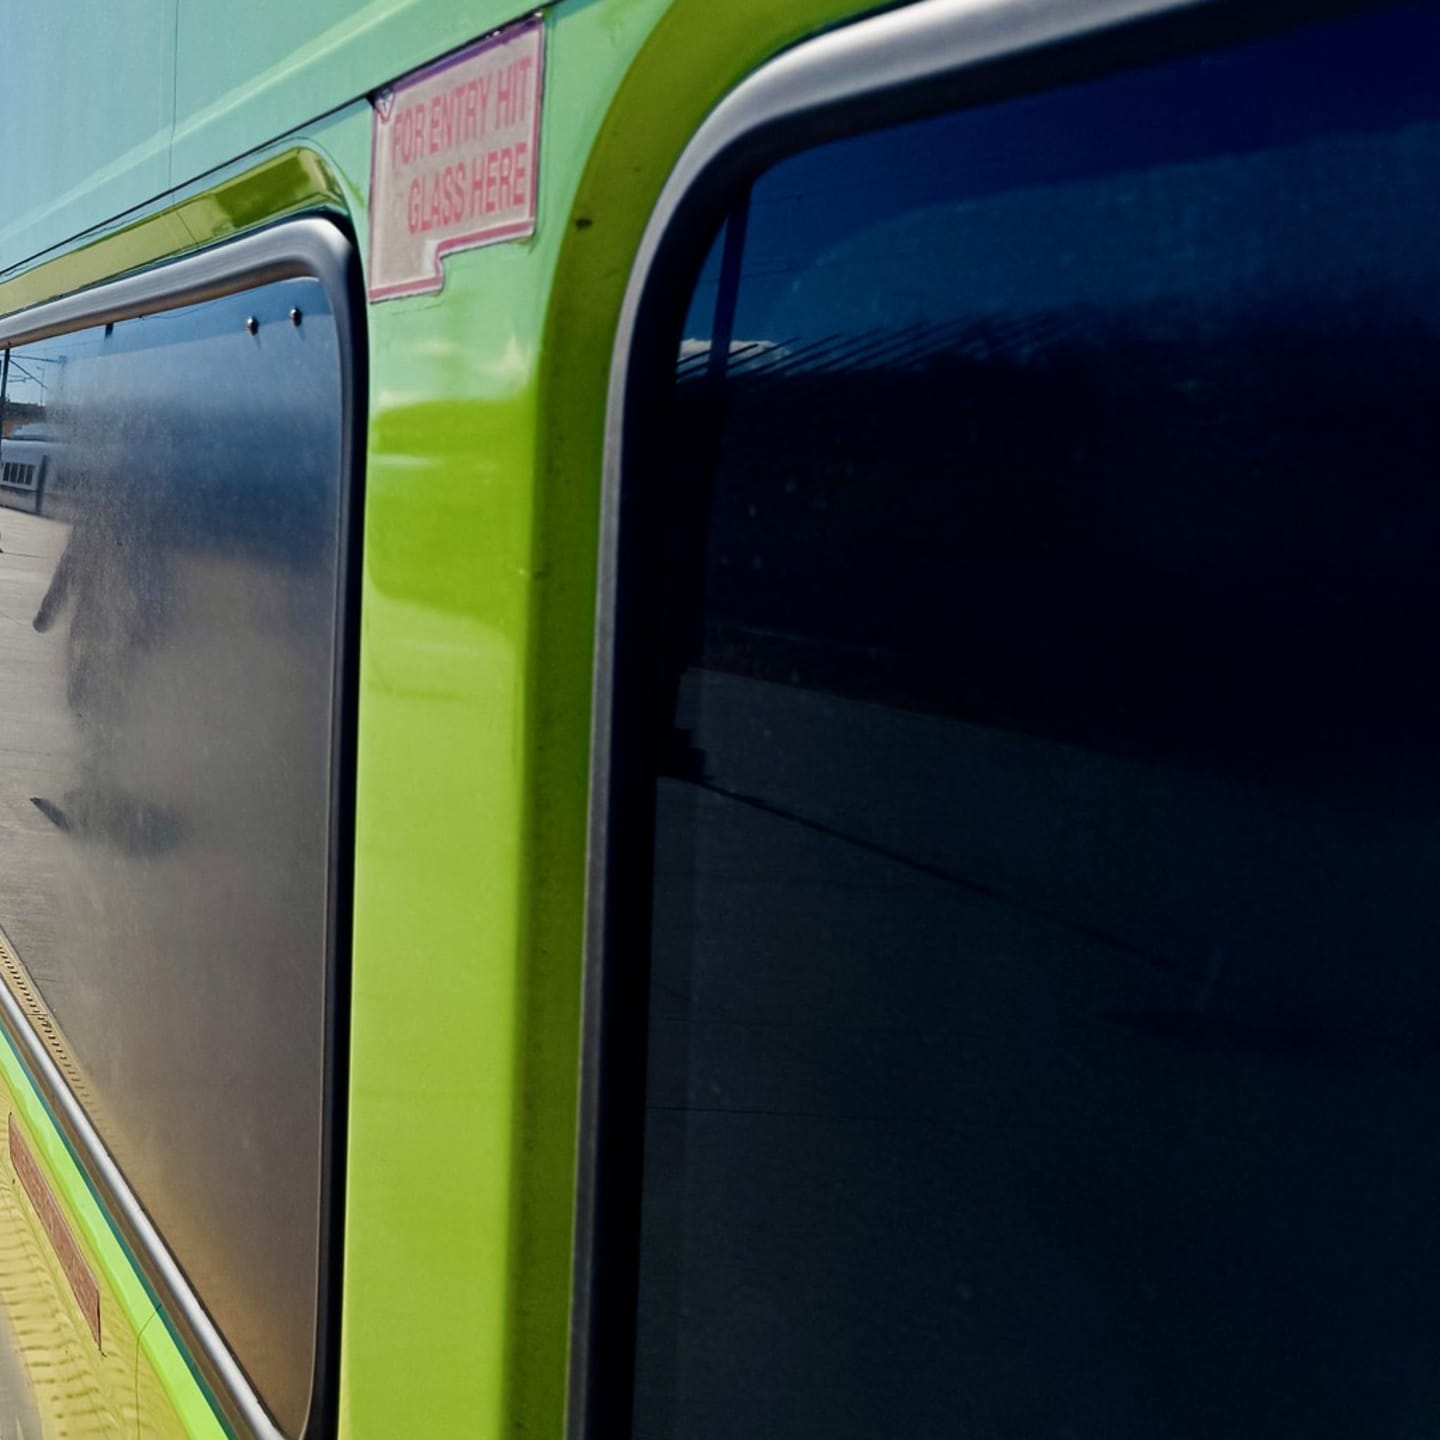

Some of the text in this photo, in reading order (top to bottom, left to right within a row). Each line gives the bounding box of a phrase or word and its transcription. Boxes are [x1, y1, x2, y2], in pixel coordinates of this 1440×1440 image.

[392, 58, 531, 168] FOR ENTRY HIT
[408, 142, 527, 235] GLASS HERE
